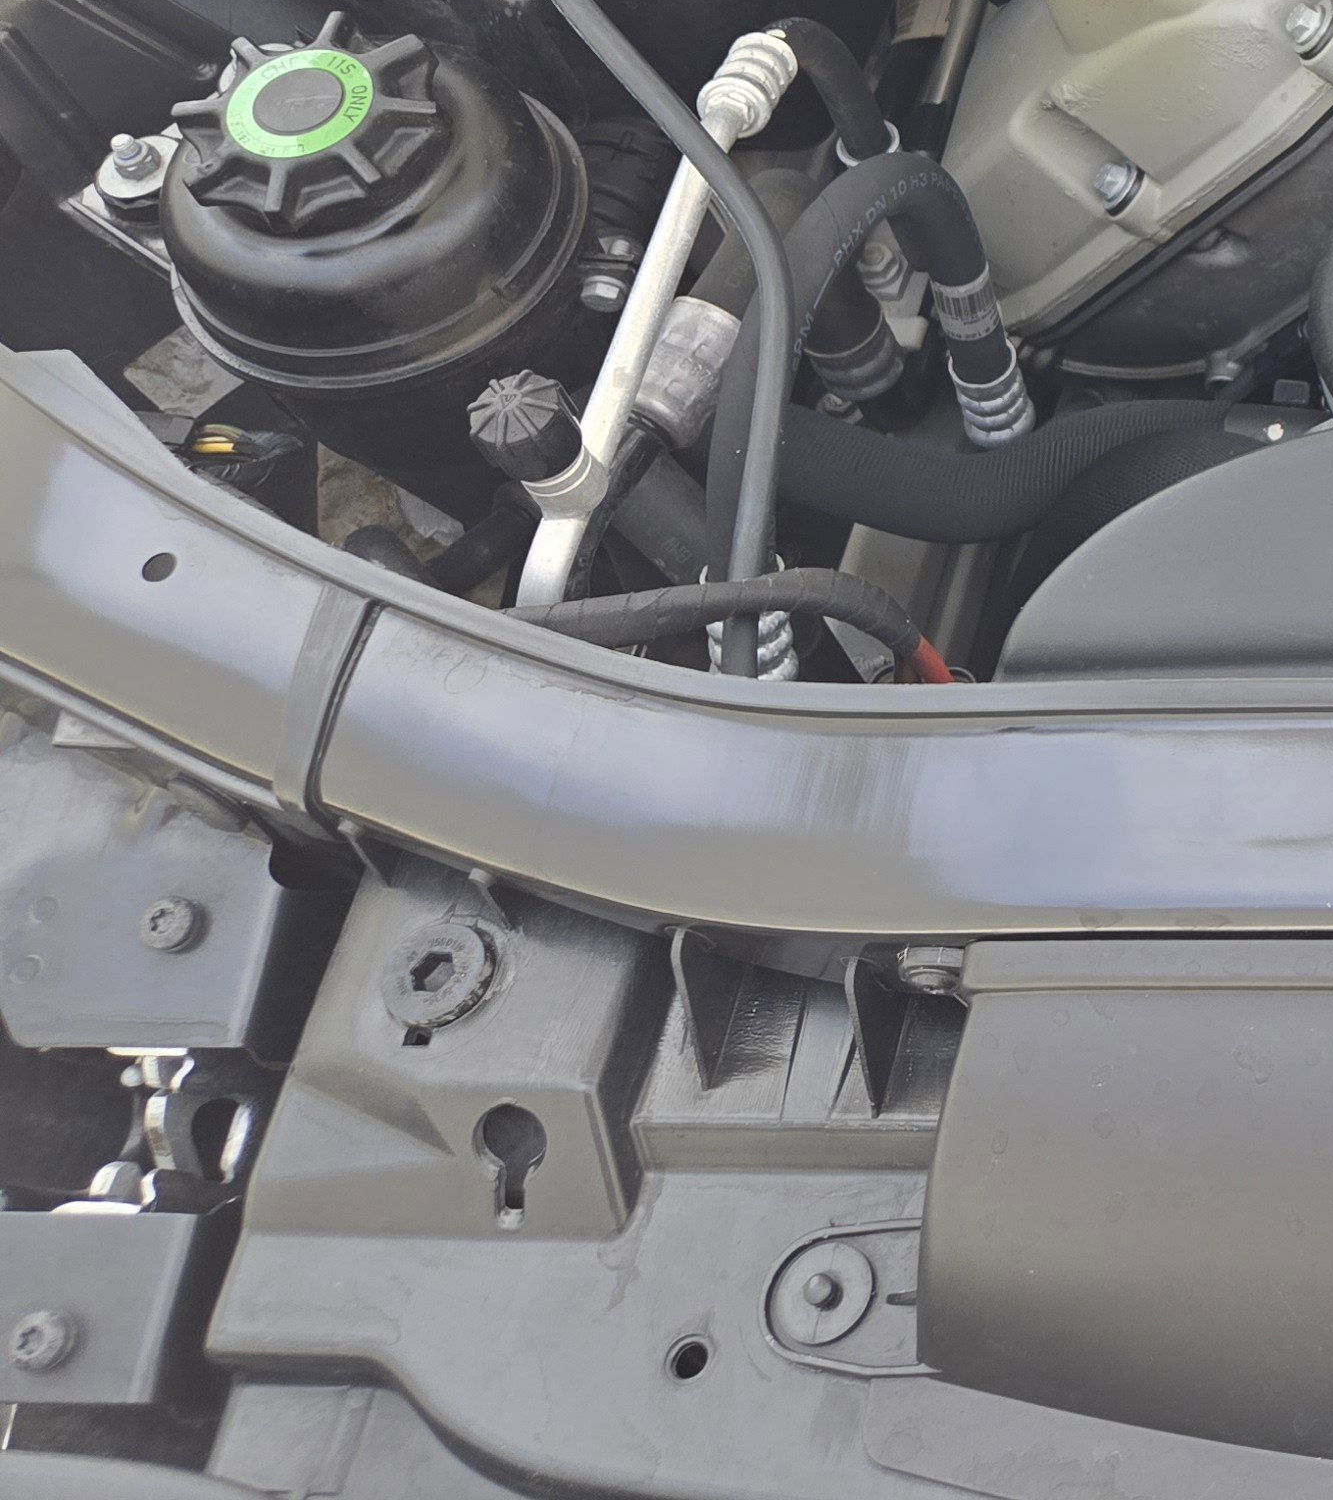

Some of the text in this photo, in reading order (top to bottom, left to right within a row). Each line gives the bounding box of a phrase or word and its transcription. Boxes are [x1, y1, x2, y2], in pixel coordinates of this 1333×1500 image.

[326, 55, 357, 76] 11S
[342, 84, 369, 124] ONLY
[866, 194, 888, 225] DN
